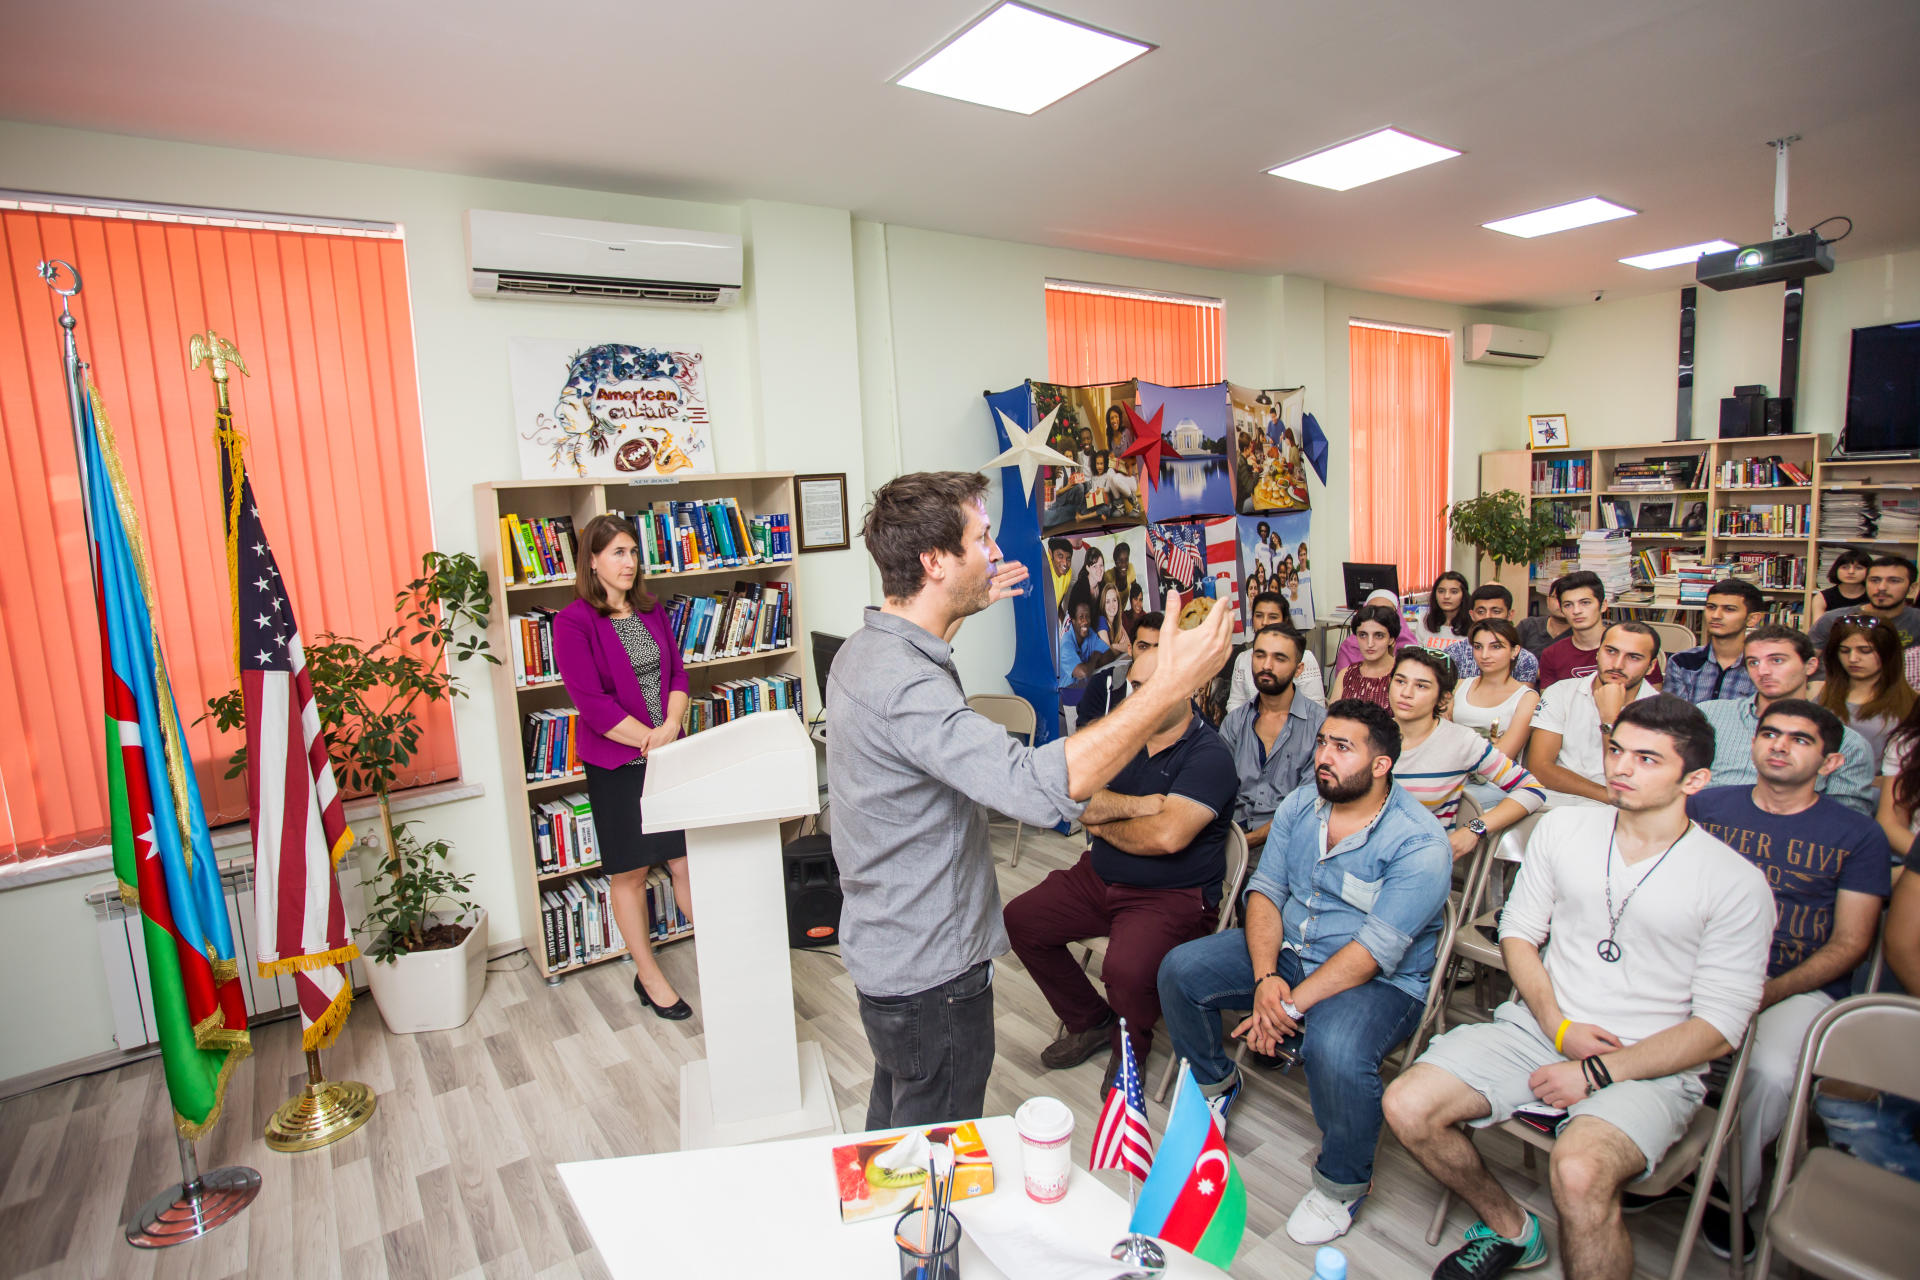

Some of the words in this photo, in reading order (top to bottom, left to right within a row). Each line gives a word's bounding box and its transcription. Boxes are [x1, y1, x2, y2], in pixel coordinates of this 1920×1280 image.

[596, 387, 678, 401] American
[1739, 555, 1764, 563] ROBERT
[1426, 636, 1461, 649] BETT
[1702, 822, 1772, 859] EVER
